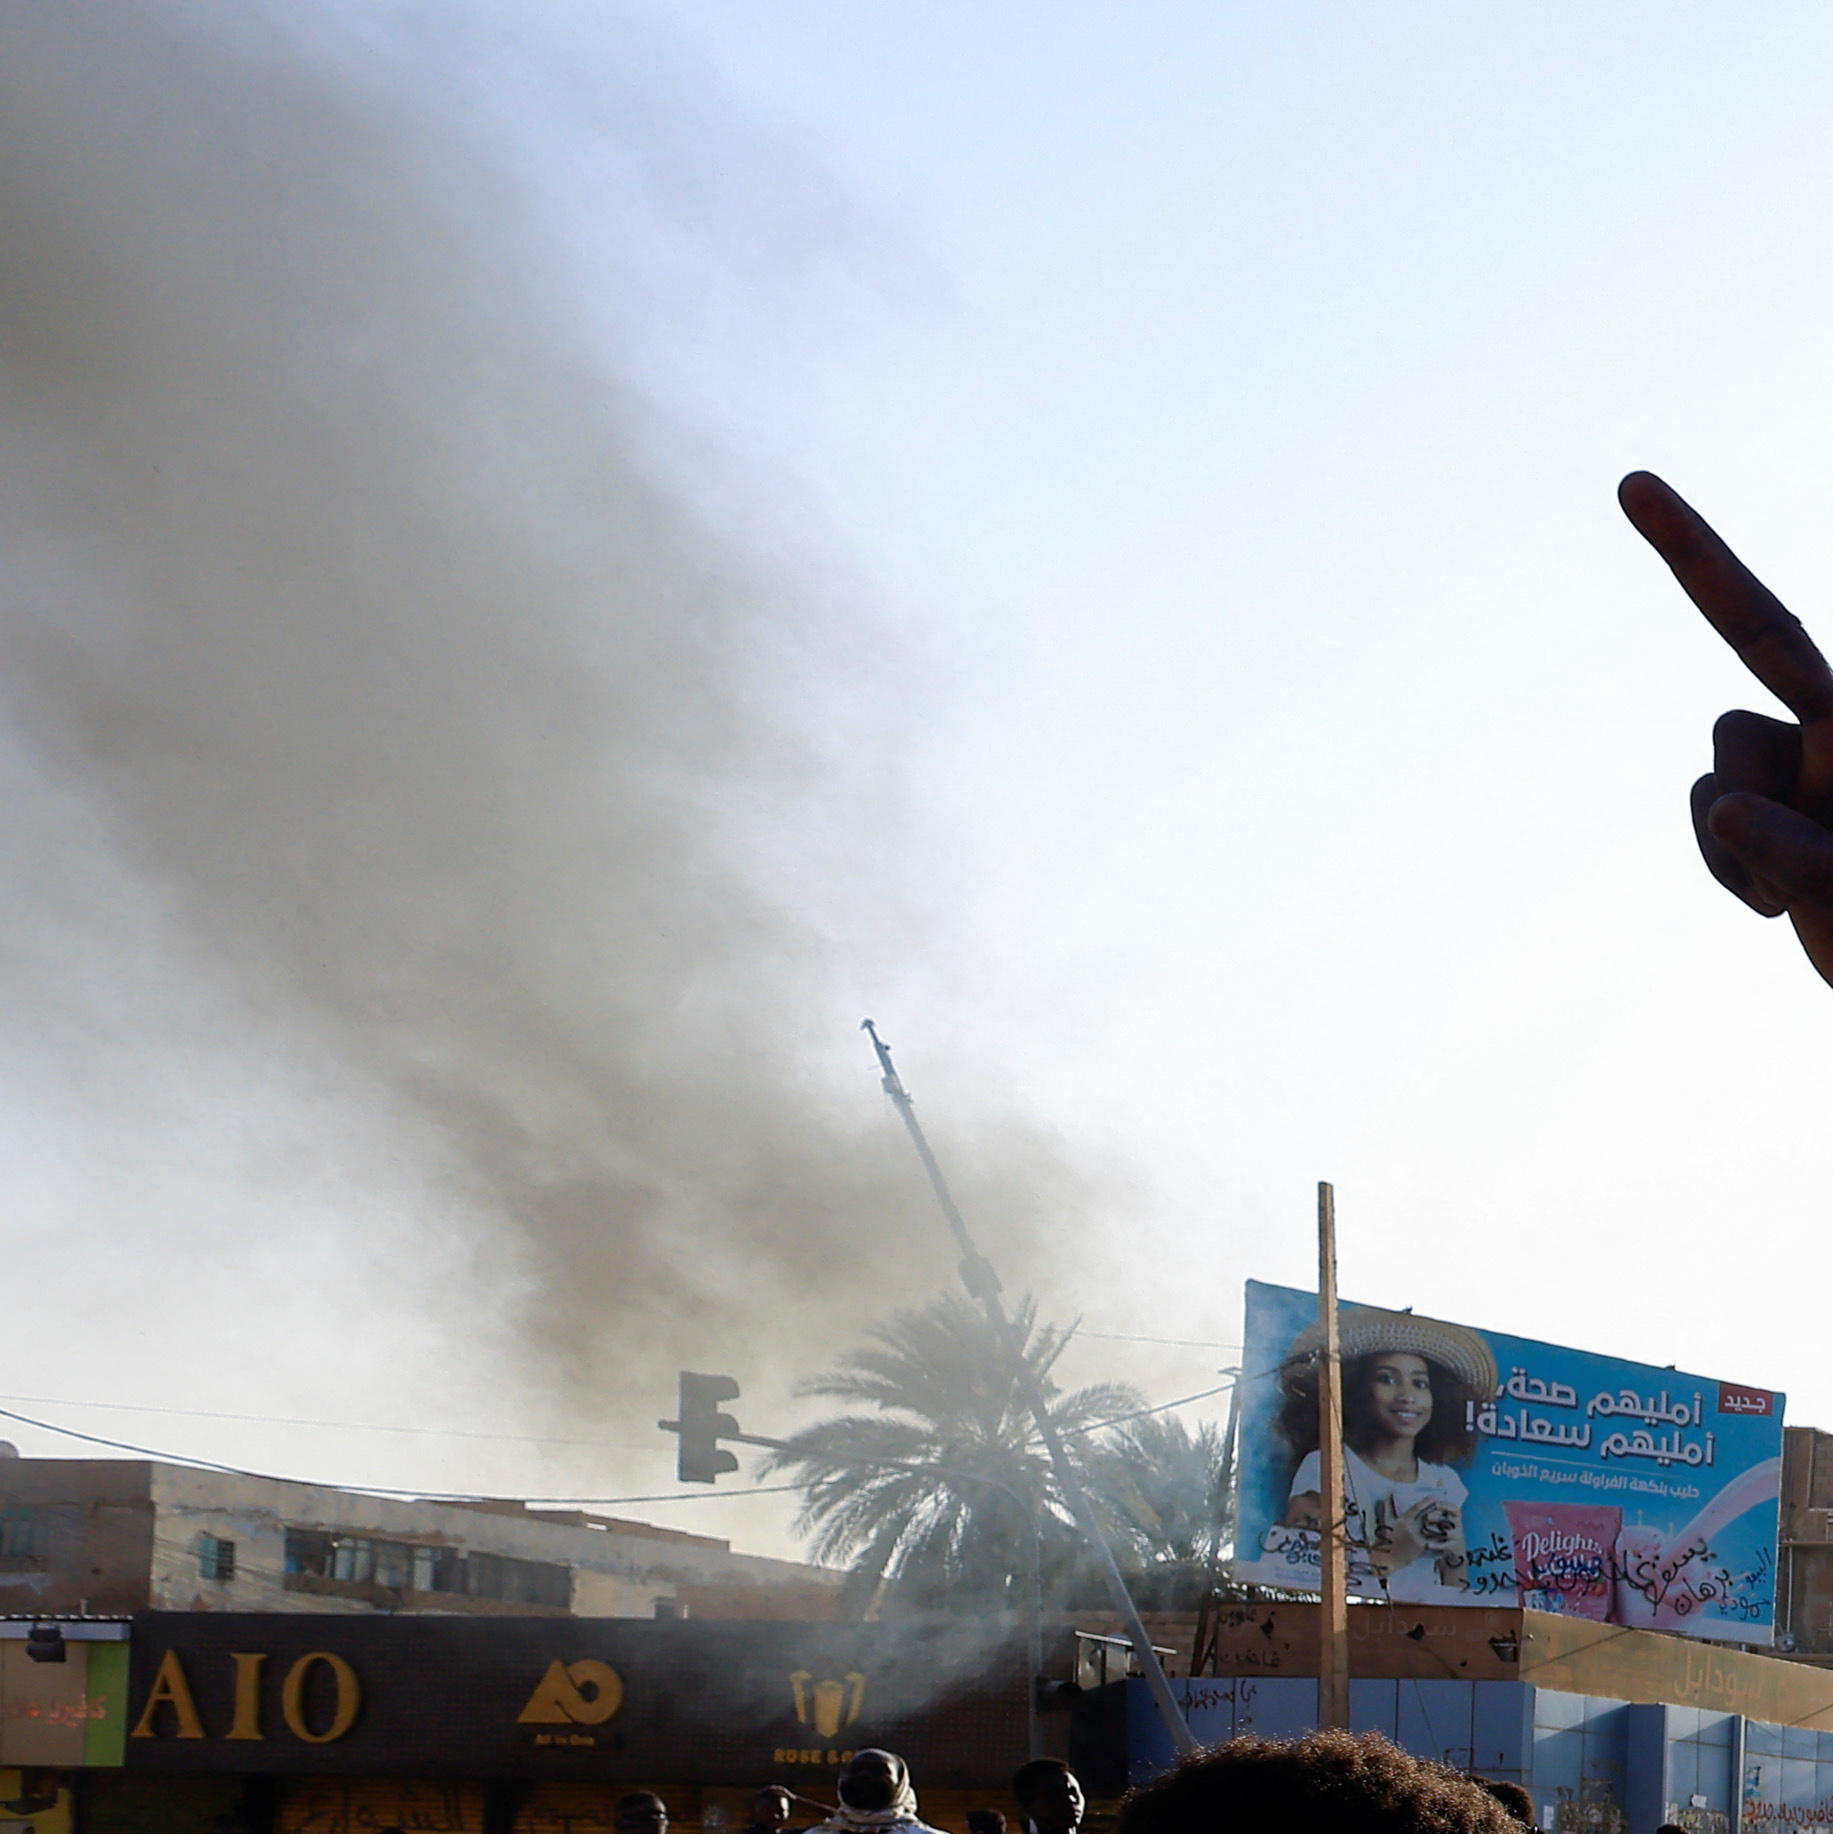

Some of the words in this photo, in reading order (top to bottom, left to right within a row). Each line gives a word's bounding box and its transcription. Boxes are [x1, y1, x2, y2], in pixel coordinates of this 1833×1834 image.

[1586, 1387, 1702, 1427] أمليهم
[1724, 1393, 1766, 1413] جديد
[1600, 1428, 1715, 1467] أمليهم
[1579, 1470, 1628, 1489] الفراولة
[1629, 1479, 1668, 1496] بنكهة
[1670, 1484, 1700, 1499] حليب
[1522, 1530, 1603, 1562] Delights
[131, 1649, 361, 1744] AIO
